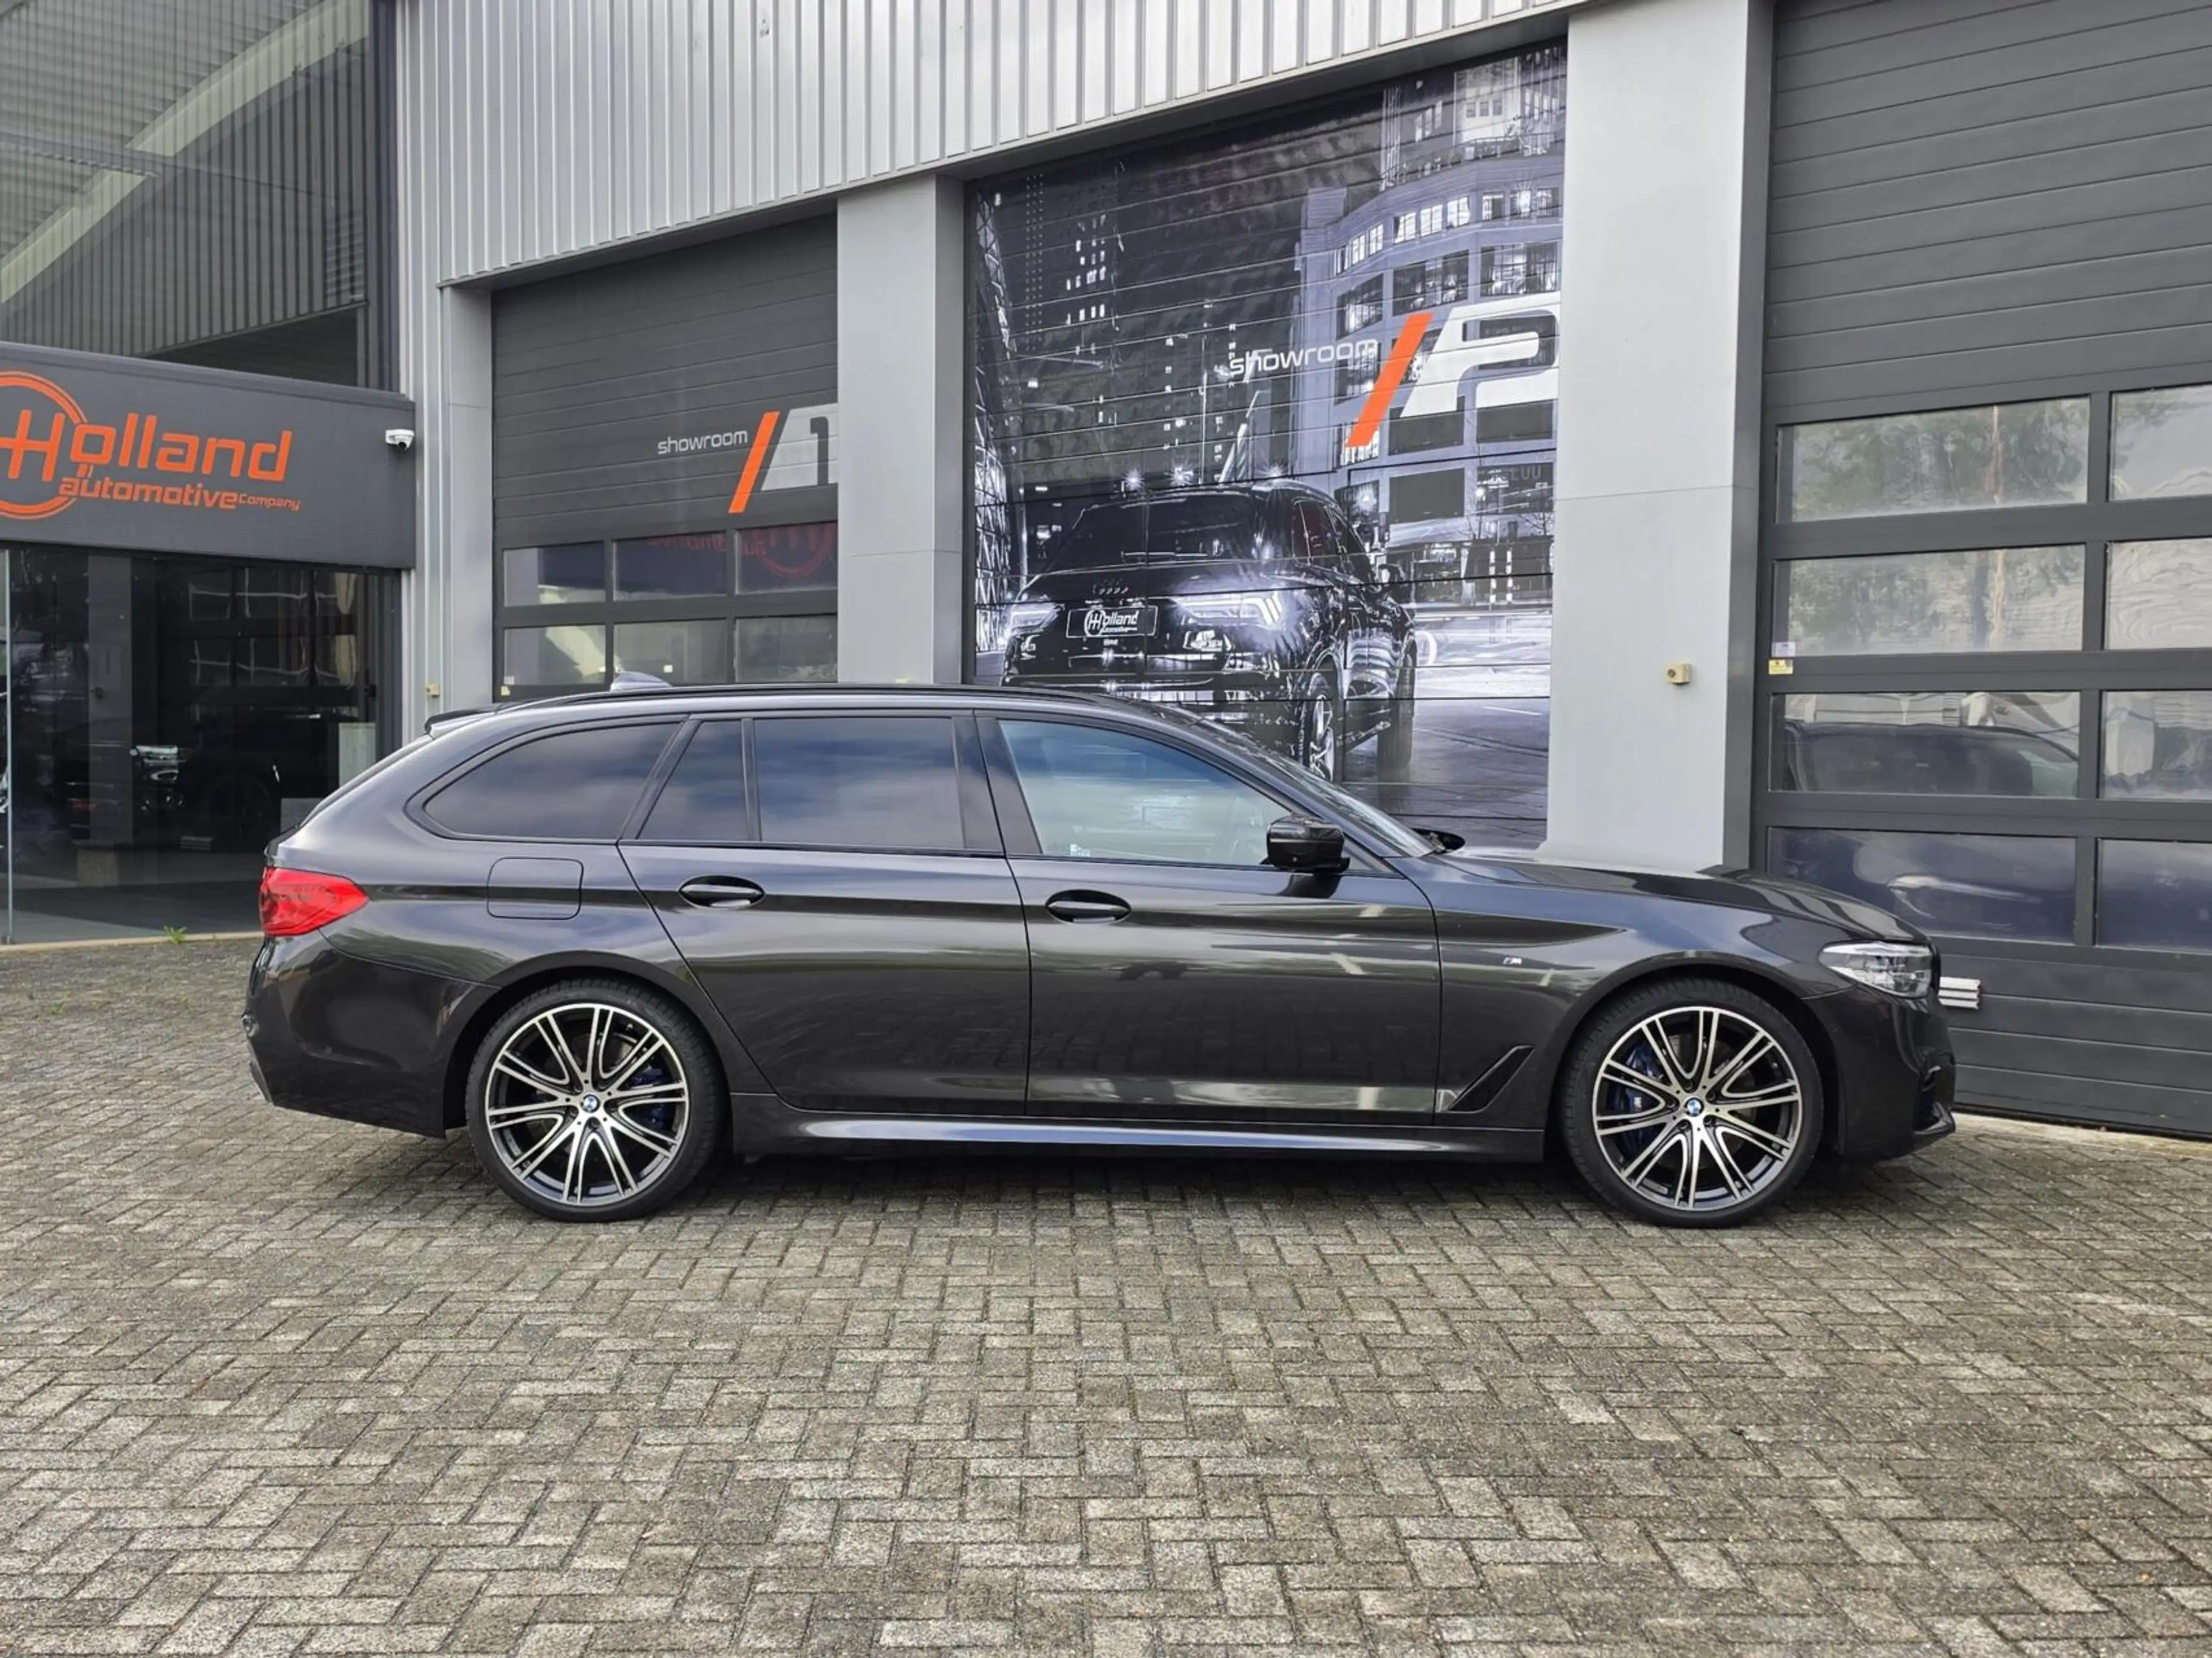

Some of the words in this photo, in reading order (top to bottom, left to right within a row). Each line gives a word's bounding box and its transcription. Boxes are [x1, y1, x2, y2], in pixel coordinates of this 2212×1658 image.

[1230, 339, 1377, 375] showroom
[658, 430, 748, 454] showroom
[59, 476, 237, 509] automotive
[1087, 610, 1139, 630] Holland
